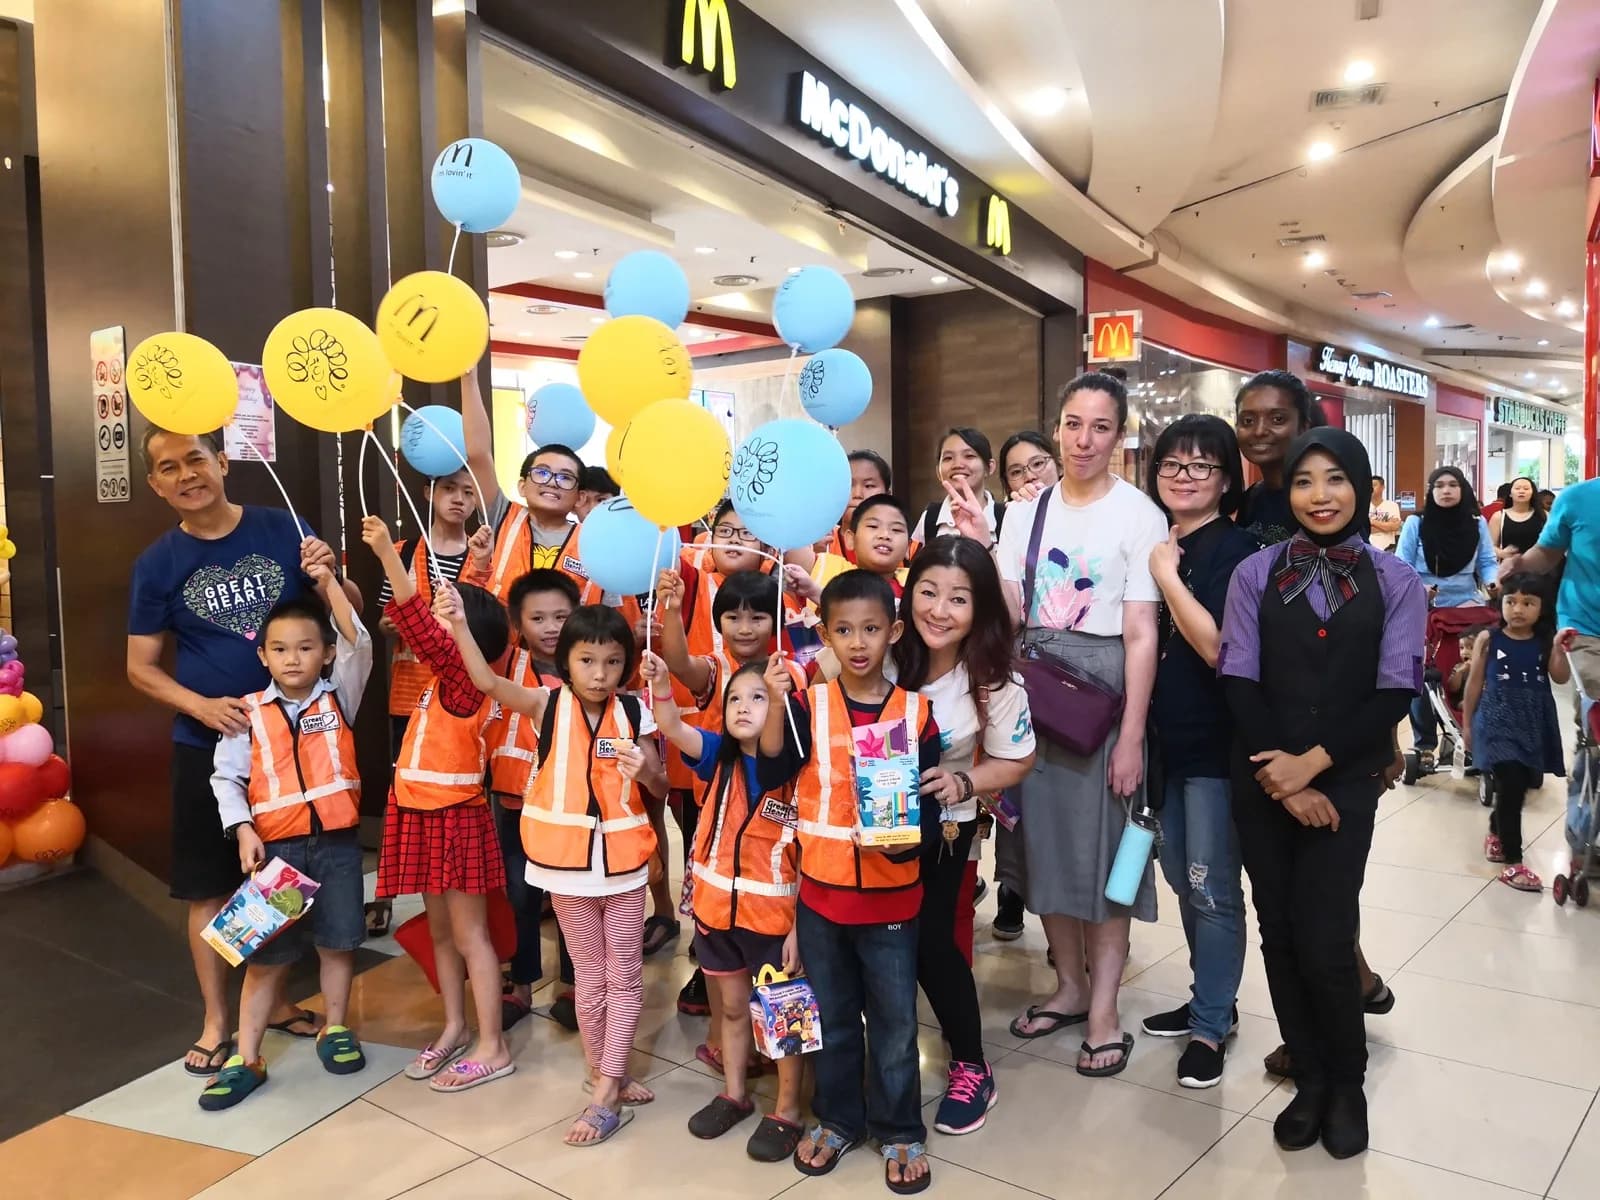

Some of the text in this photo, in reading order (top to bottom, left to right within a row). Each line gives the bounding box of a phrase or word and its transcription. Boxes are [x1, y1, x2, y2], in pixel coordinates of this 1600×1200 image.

[799, 70, 960, 217] McDonald's
[1319, 346, 1429, 398] Kenny Rogers ROASTERS
[1498, 398, 1545, 432] STARBUCKS
[204, 573, 262, 598] GREAT
[206, 585, 267, 611] HEART
[887, 922, 902, 931] BOY
